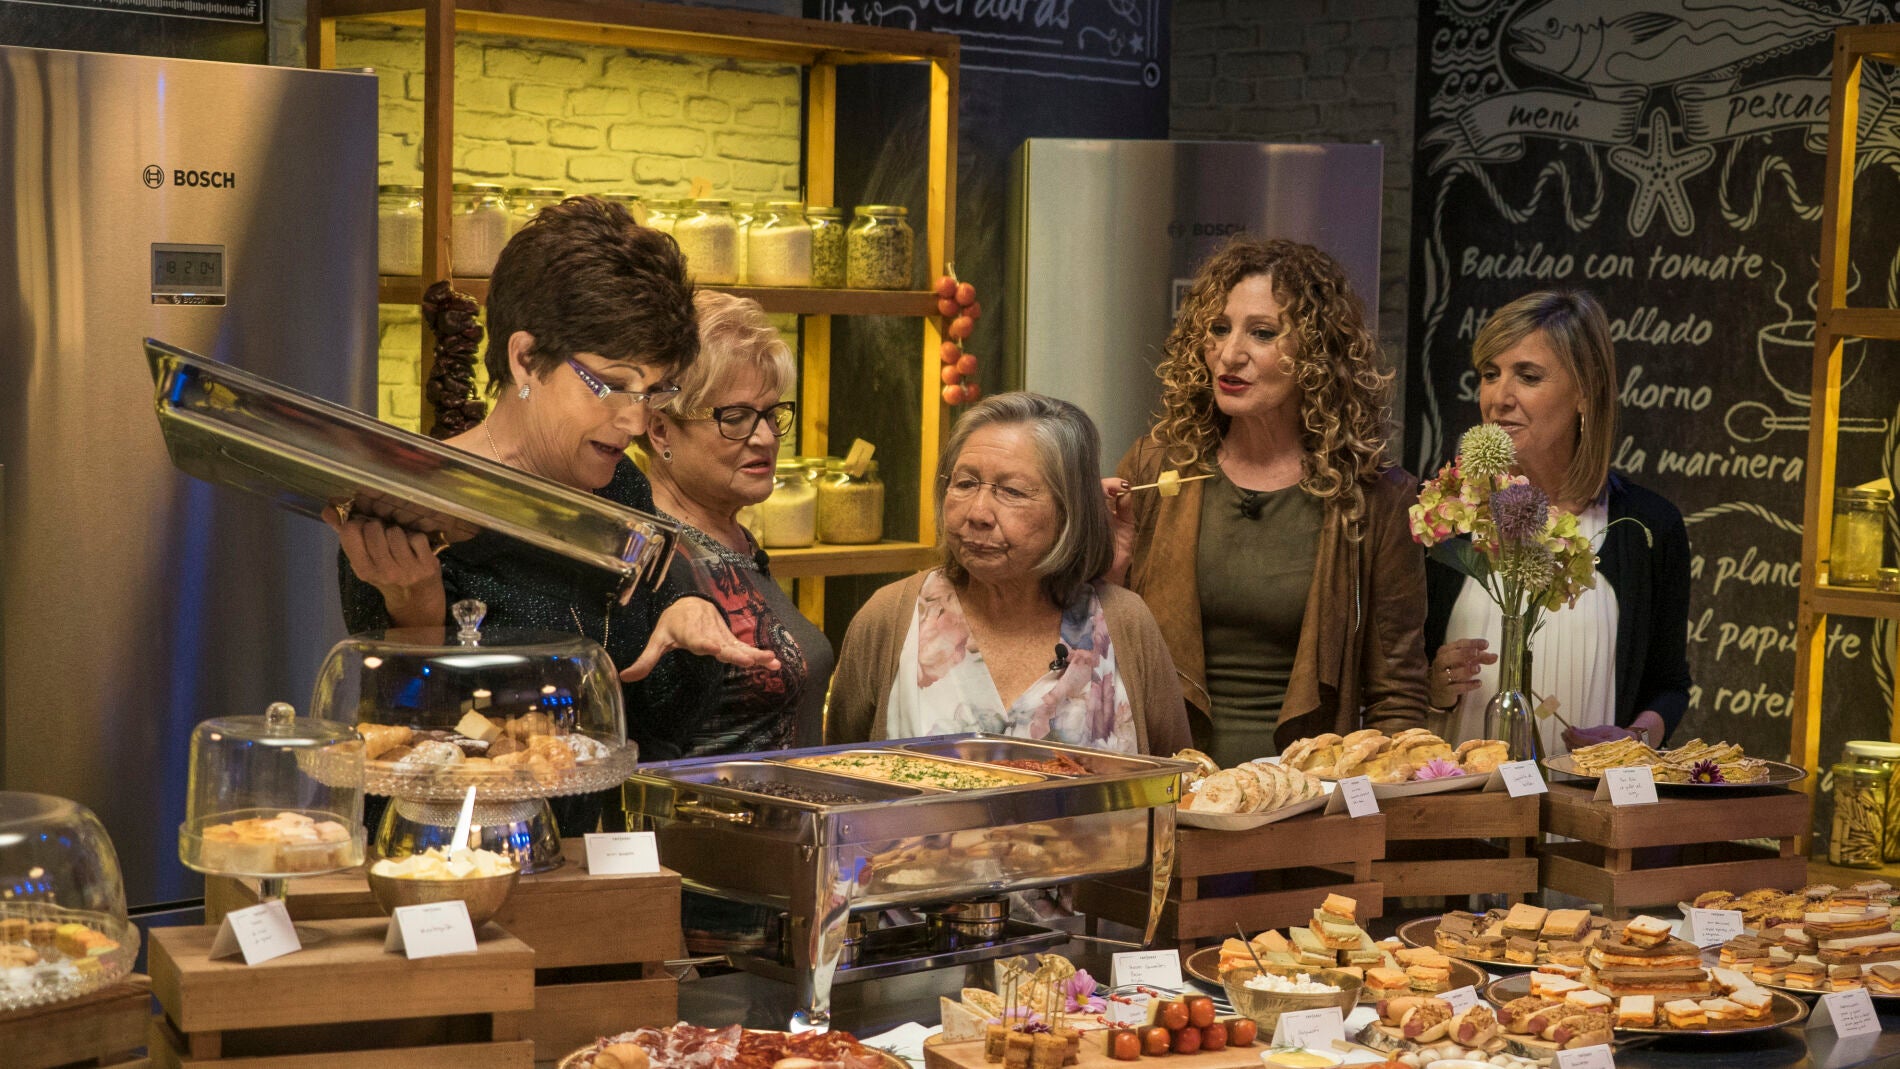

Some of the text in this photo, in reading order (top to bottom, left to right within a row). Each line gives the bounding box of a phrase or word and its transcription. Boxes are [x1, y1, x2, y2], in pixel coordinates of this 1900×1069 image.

[1508, 101, 1582, 131] menú
[173, 170, 235, 189] BOSCH
[1584, 253, 1633, 279] con
[1648, 245, 1763, 280] tomate
[1611, 306, 1713, 346] ollado
[1617, 365, 1712, 410] horno
[1611, 436, 1804, 482] la marinera
[1713, 546, 1802, 596] planc
